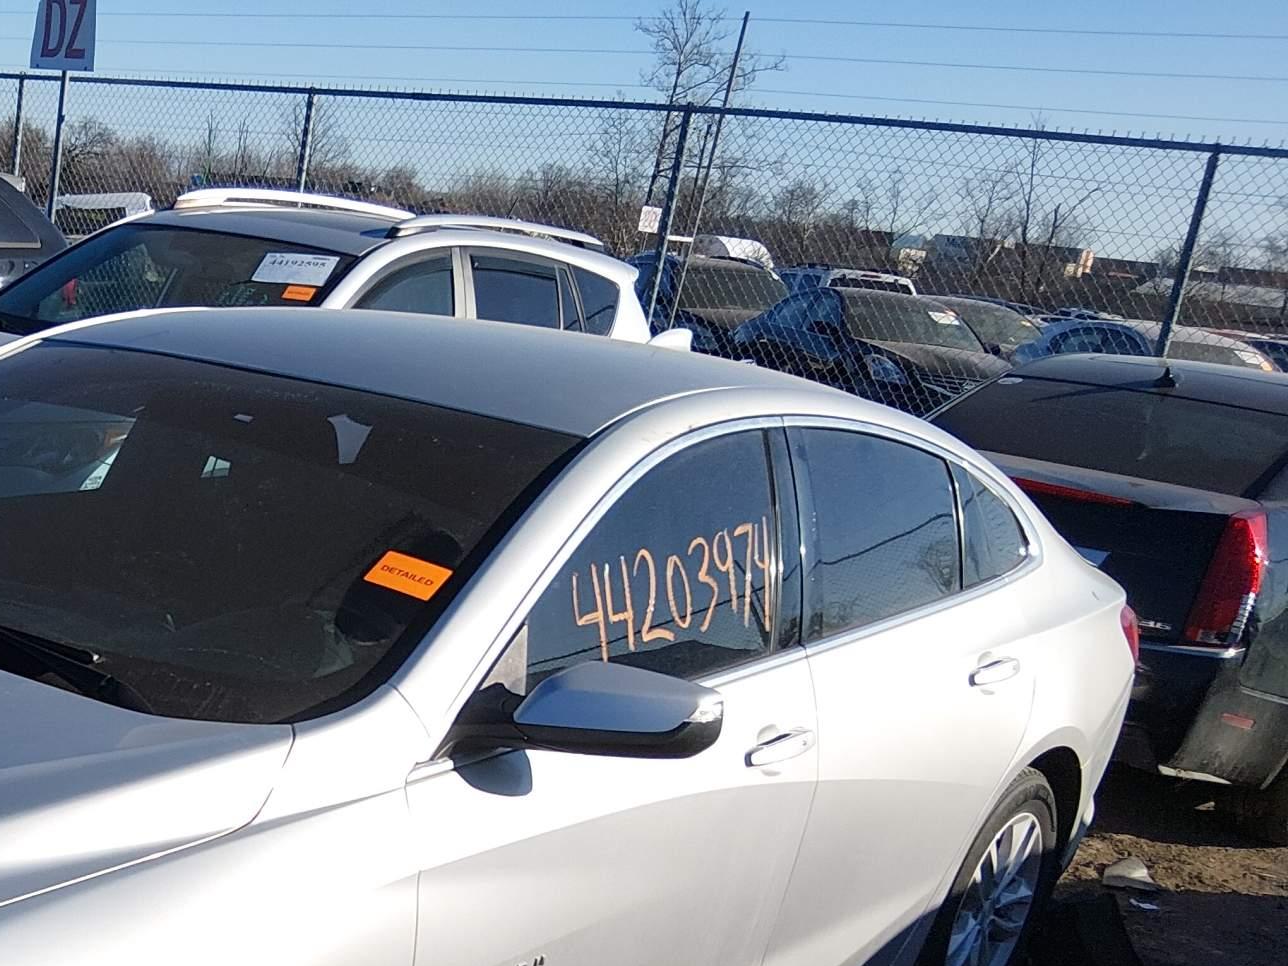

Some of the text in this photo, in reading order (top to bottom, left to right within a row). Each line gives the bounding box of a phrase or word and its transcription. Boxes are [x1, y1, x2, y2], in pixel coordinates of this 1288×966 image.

[40, 0, 87, 59] DZ
[380, 564, 434, 586] DETAILED
[572, 516, 771, 663] 44203974
